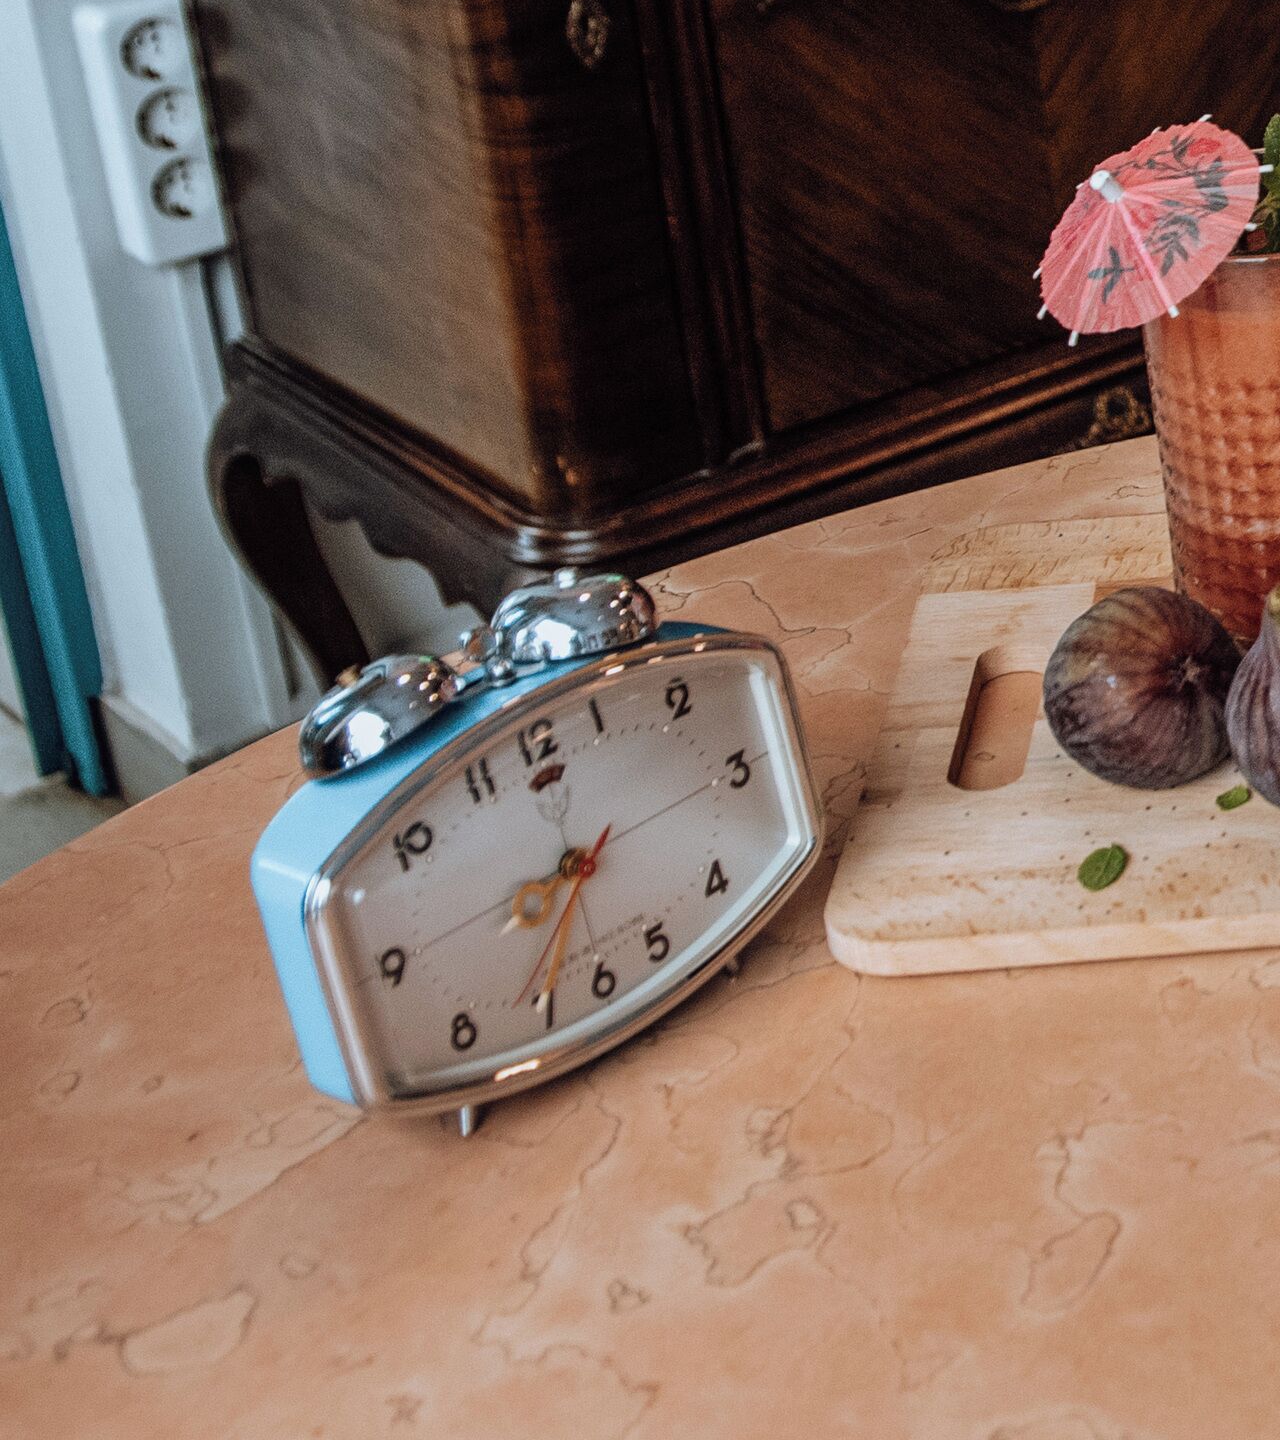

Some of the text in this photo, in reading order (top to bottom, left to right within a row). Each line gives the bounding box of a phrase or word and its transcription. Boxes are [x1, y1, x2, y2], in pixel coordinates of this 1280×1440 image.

[588, 696, 604, 733] 1
[665, 677, 693, 721] 2
[516, 718, 560, 767] 12
[464, 757, 496, 804] 11
[725, 748, 751, 789] 3
[392, 821, 433, 872] 10
[705, 858, 729, 898] 4
[644, 921, 670, 963] 5
[379, 947, 406, 988] 9
[591, 960, 616, 999] 6
[450, 1012, 477, 1052] 8
